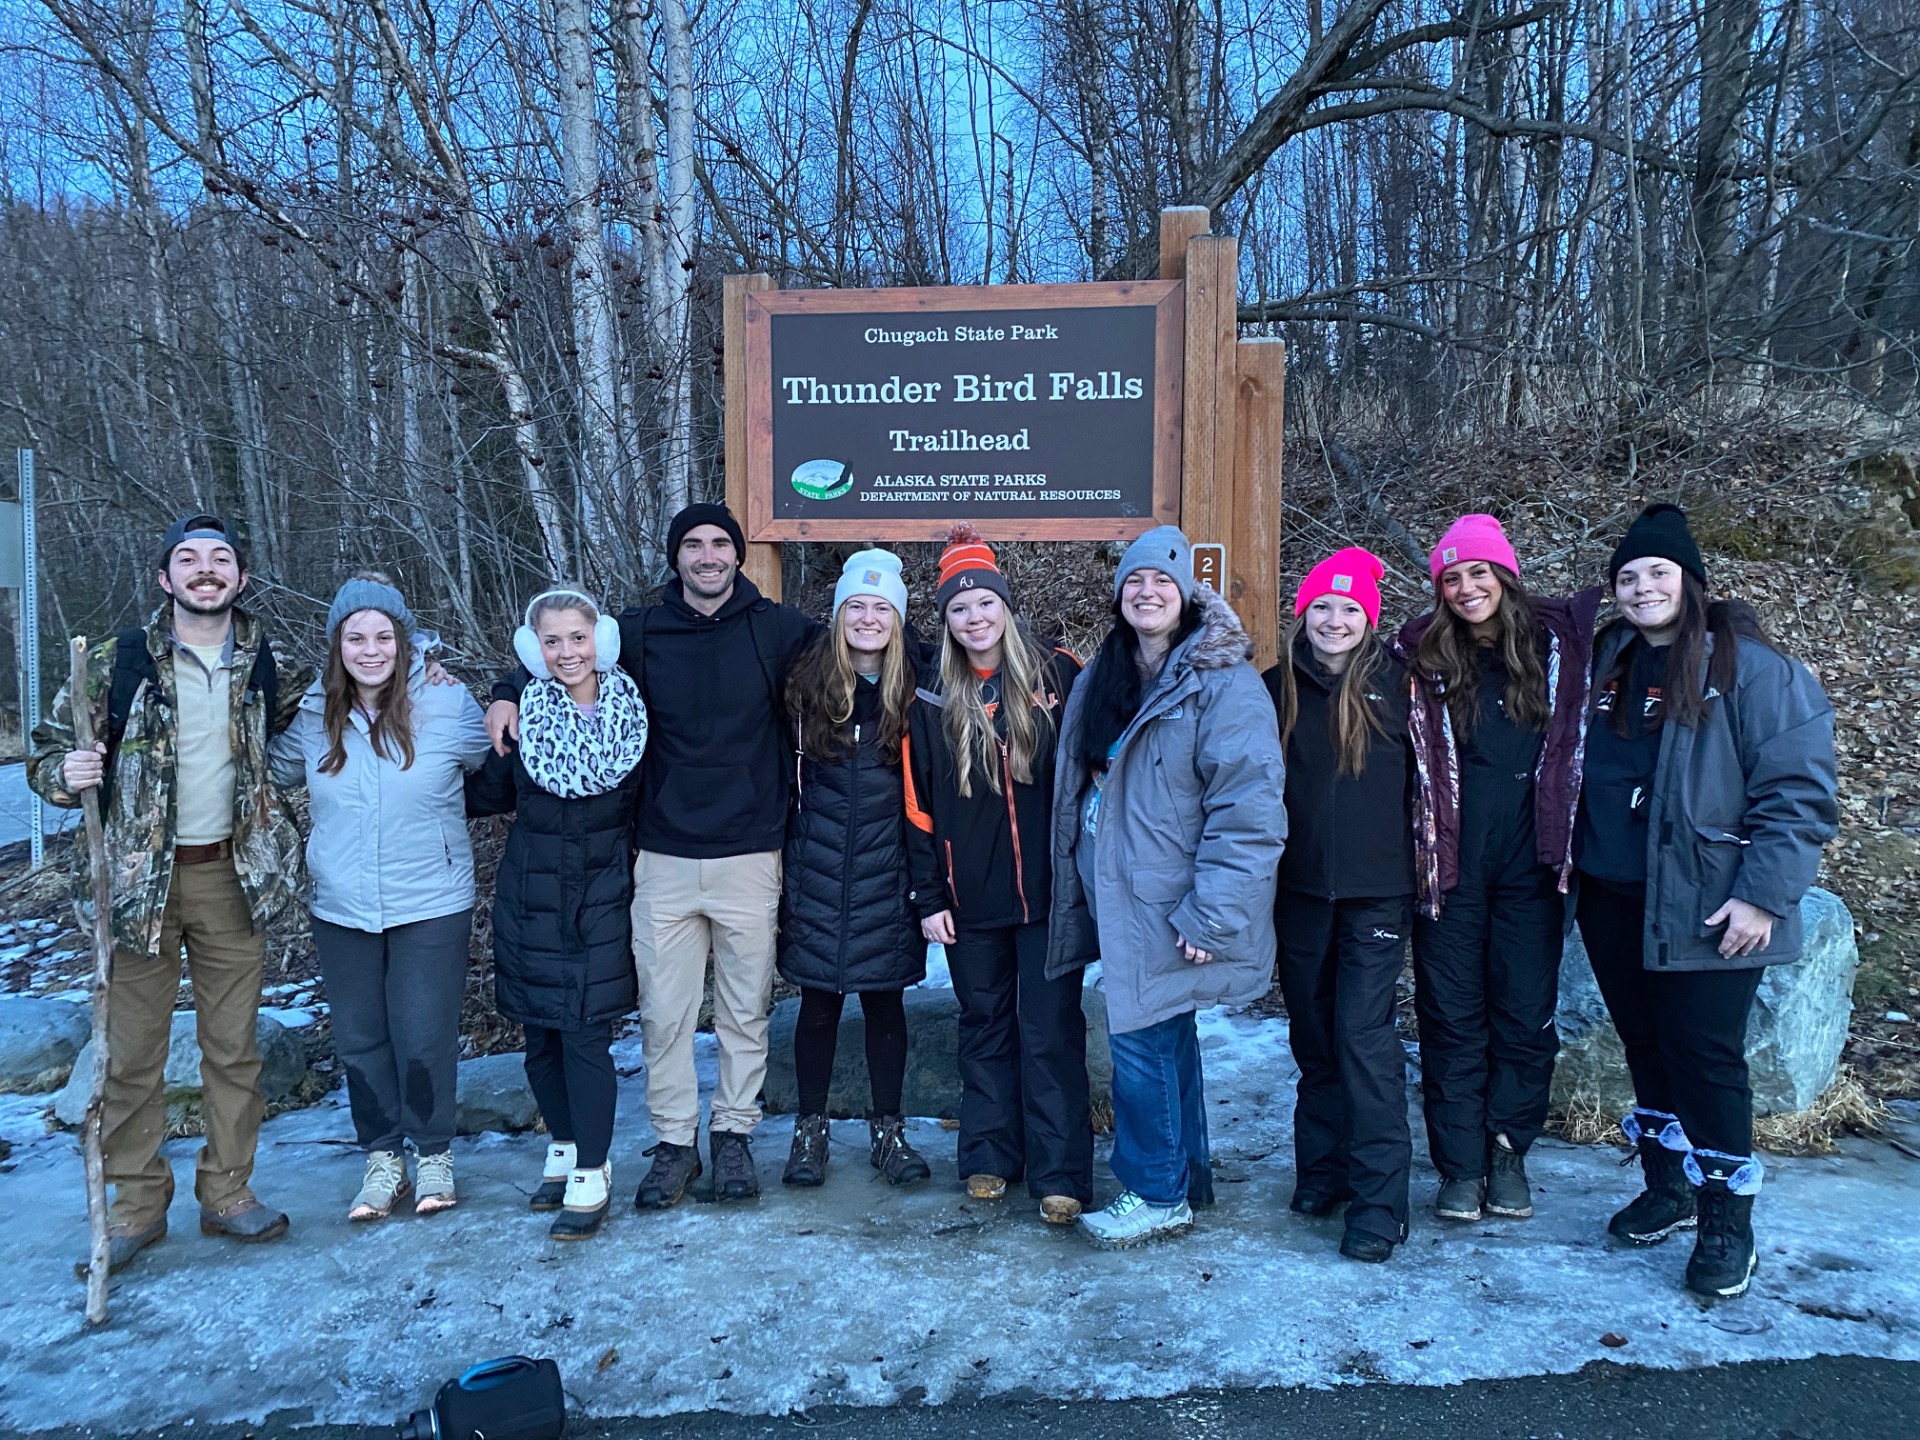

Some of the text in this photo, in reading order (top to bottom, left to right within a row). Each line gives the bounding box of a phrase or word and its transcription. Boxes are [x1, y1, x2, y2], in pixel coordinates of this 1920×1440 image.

[864, 324, 1059, 346] Chugach State Park
[782, 371, 1143, 404] Thunder Bird Falls
[889, 428, 1030, 451] Trailhead
[873, 473, 1047, 487] ALASKA STATE PARKS
[799, 487, 847, 500] STATE PARKS
[859, 489, 1121, 502] DEPARTMENT OF NATURAL RESOURCES
